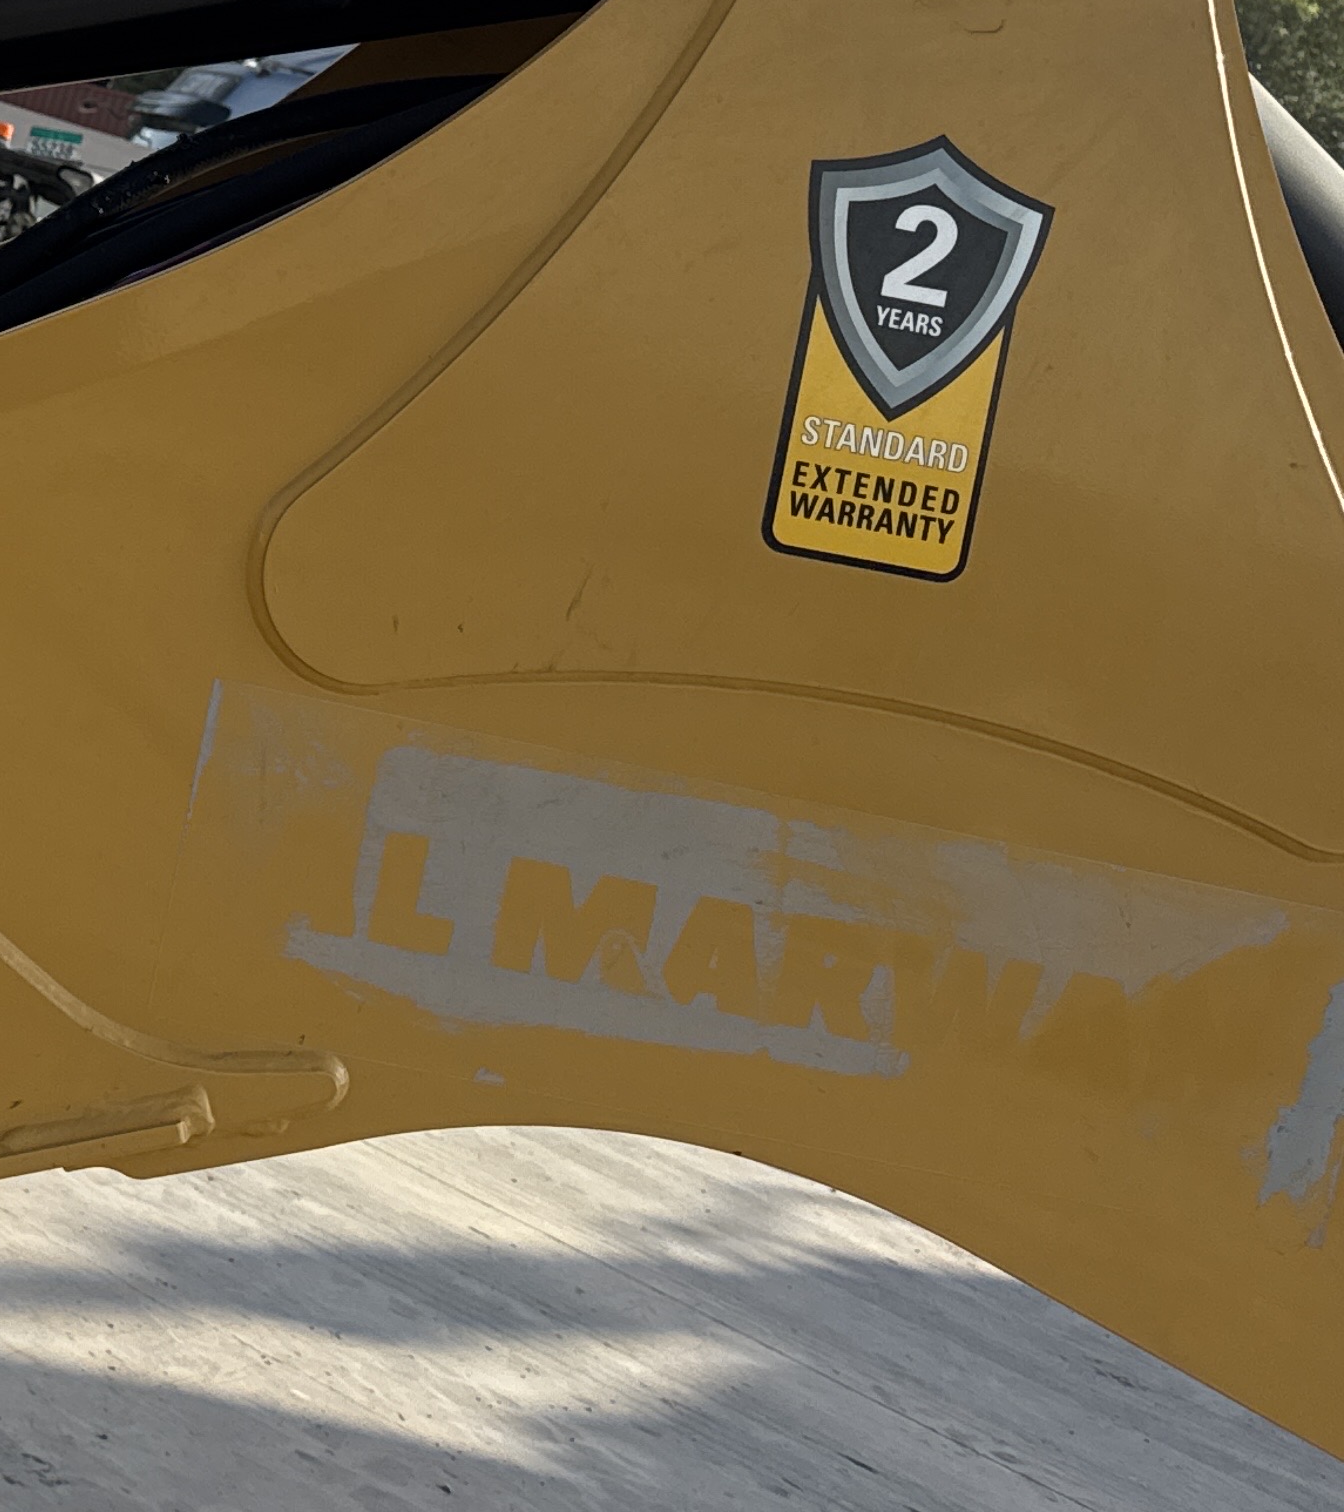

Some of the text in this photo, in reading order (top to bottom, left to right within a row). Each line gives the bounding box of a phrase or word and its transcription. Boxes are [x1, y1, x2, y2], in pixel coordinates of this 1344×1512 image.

[880, 204, 959, 308] 2
[876, 304, 944, 337] YEARS
[800, 415, 969, 474] STANDARD
[791, 460, 960, 516] EXTENDED
[790, 490, 955, 545] WARRANTY
[490, 856, 1137, 1056] MARWA
